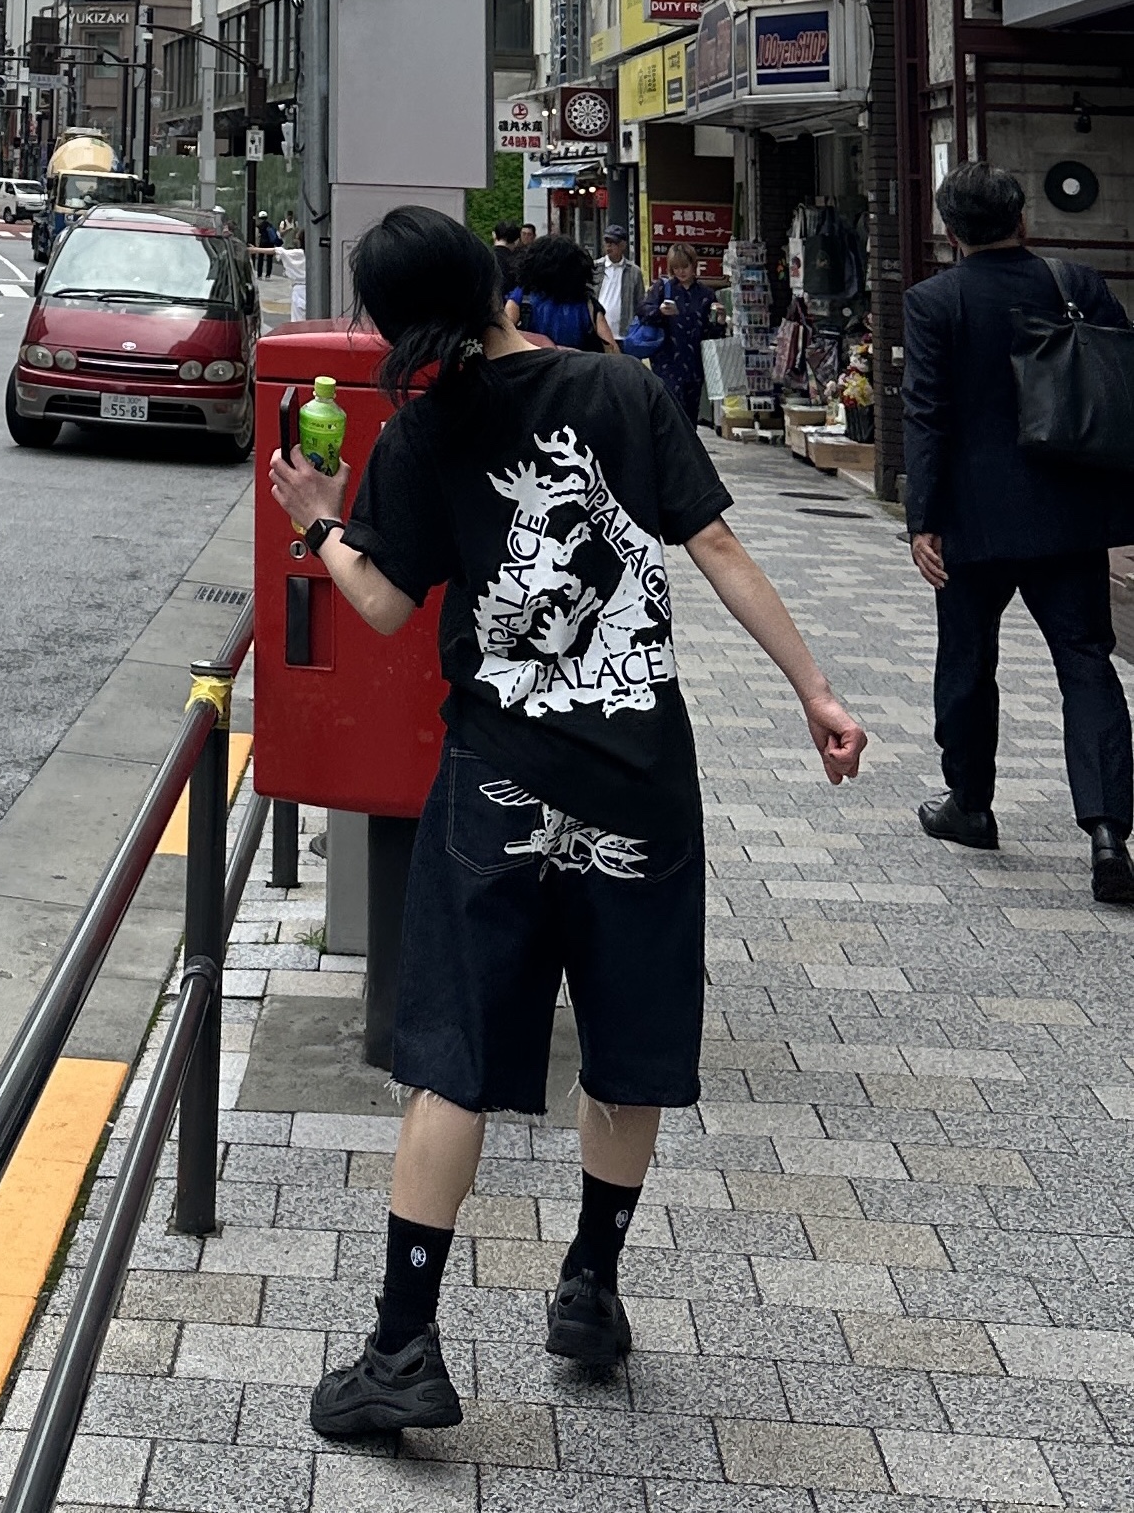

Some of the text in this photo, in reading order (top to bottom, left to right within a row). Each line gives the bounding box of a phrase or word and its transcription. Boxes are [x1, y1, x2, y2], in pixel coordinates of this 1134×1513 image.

[651, 1, 681, 13] DUTY
[69, 12, 130, 24] YUKIZAKI
[501, 135, 541, 148] 24時間
[110, 403, 146, 419] 55-85
[486, 509, 549, 649] PALACE
[533, 646, 668, 693] PALACE
